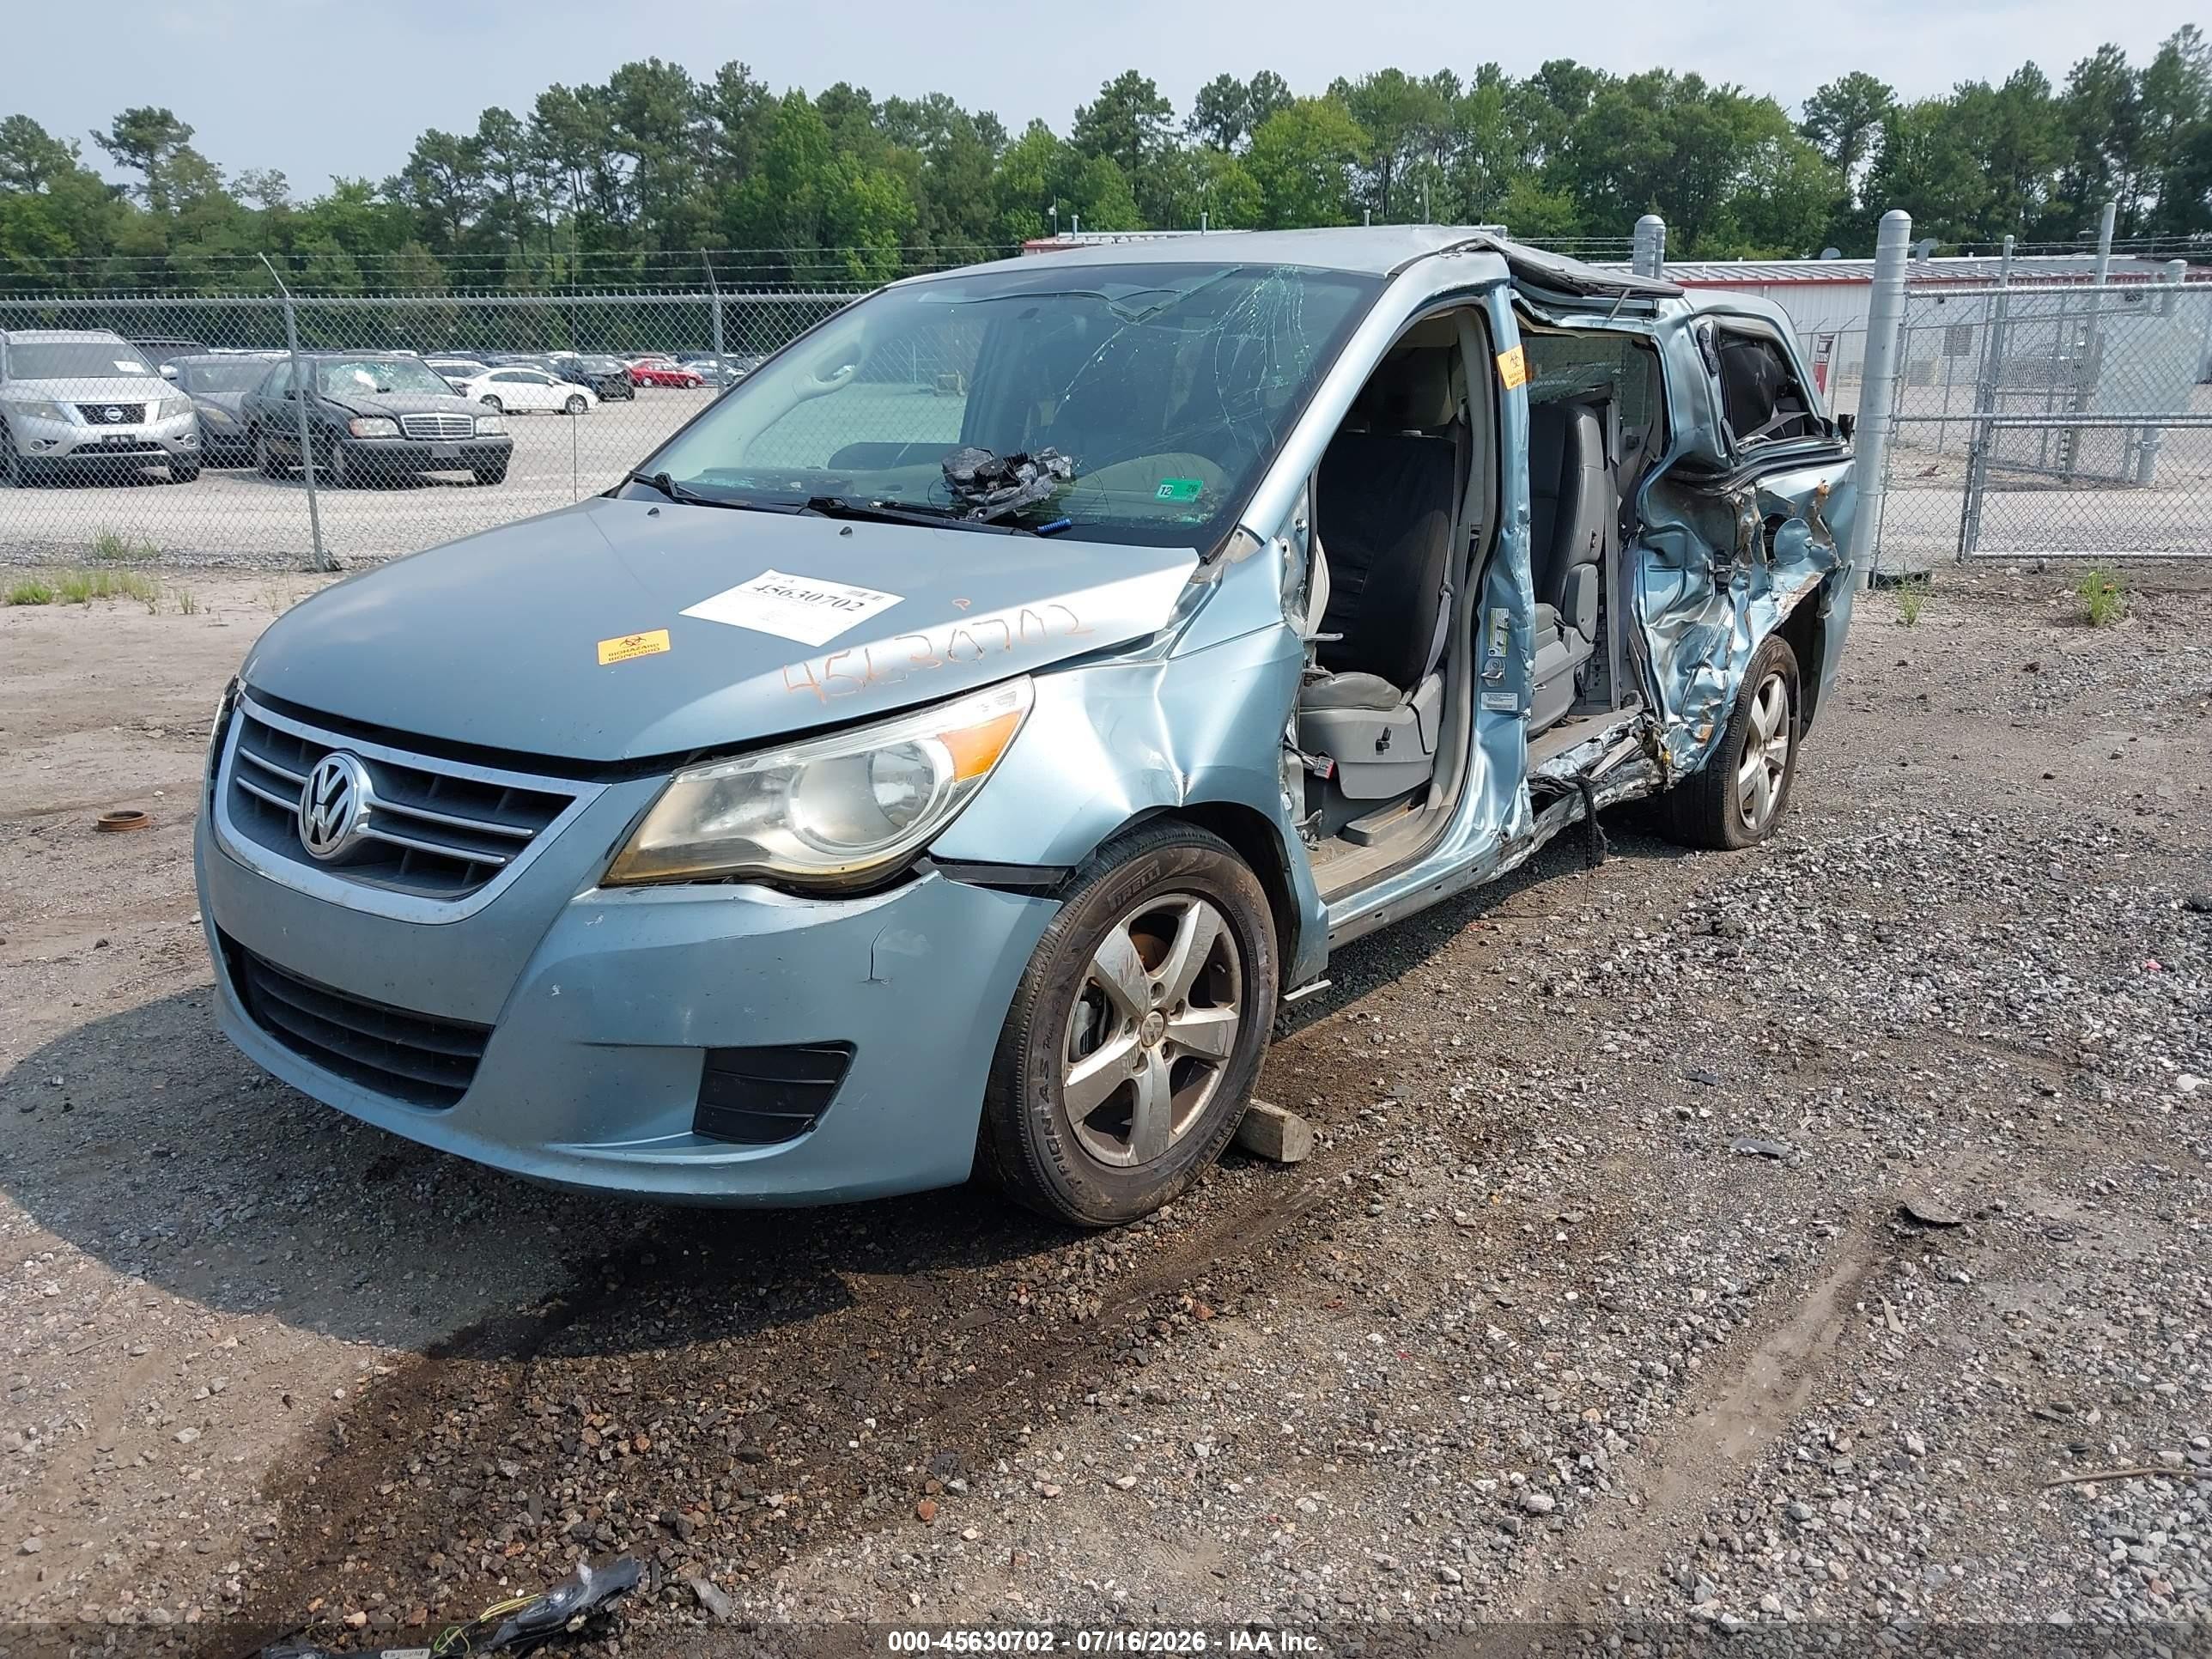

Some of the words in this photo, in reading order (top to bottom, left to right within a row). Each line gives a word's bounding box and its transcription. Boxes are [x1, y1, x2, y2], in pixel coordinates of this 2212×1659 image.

[1160, 486, 1173, 495] 12
[752, 583, 866, 611] 45630702
[608, 642, 659, 657] BIOHAZARD
[1107, 860, 1161, 912] PIRELLI
